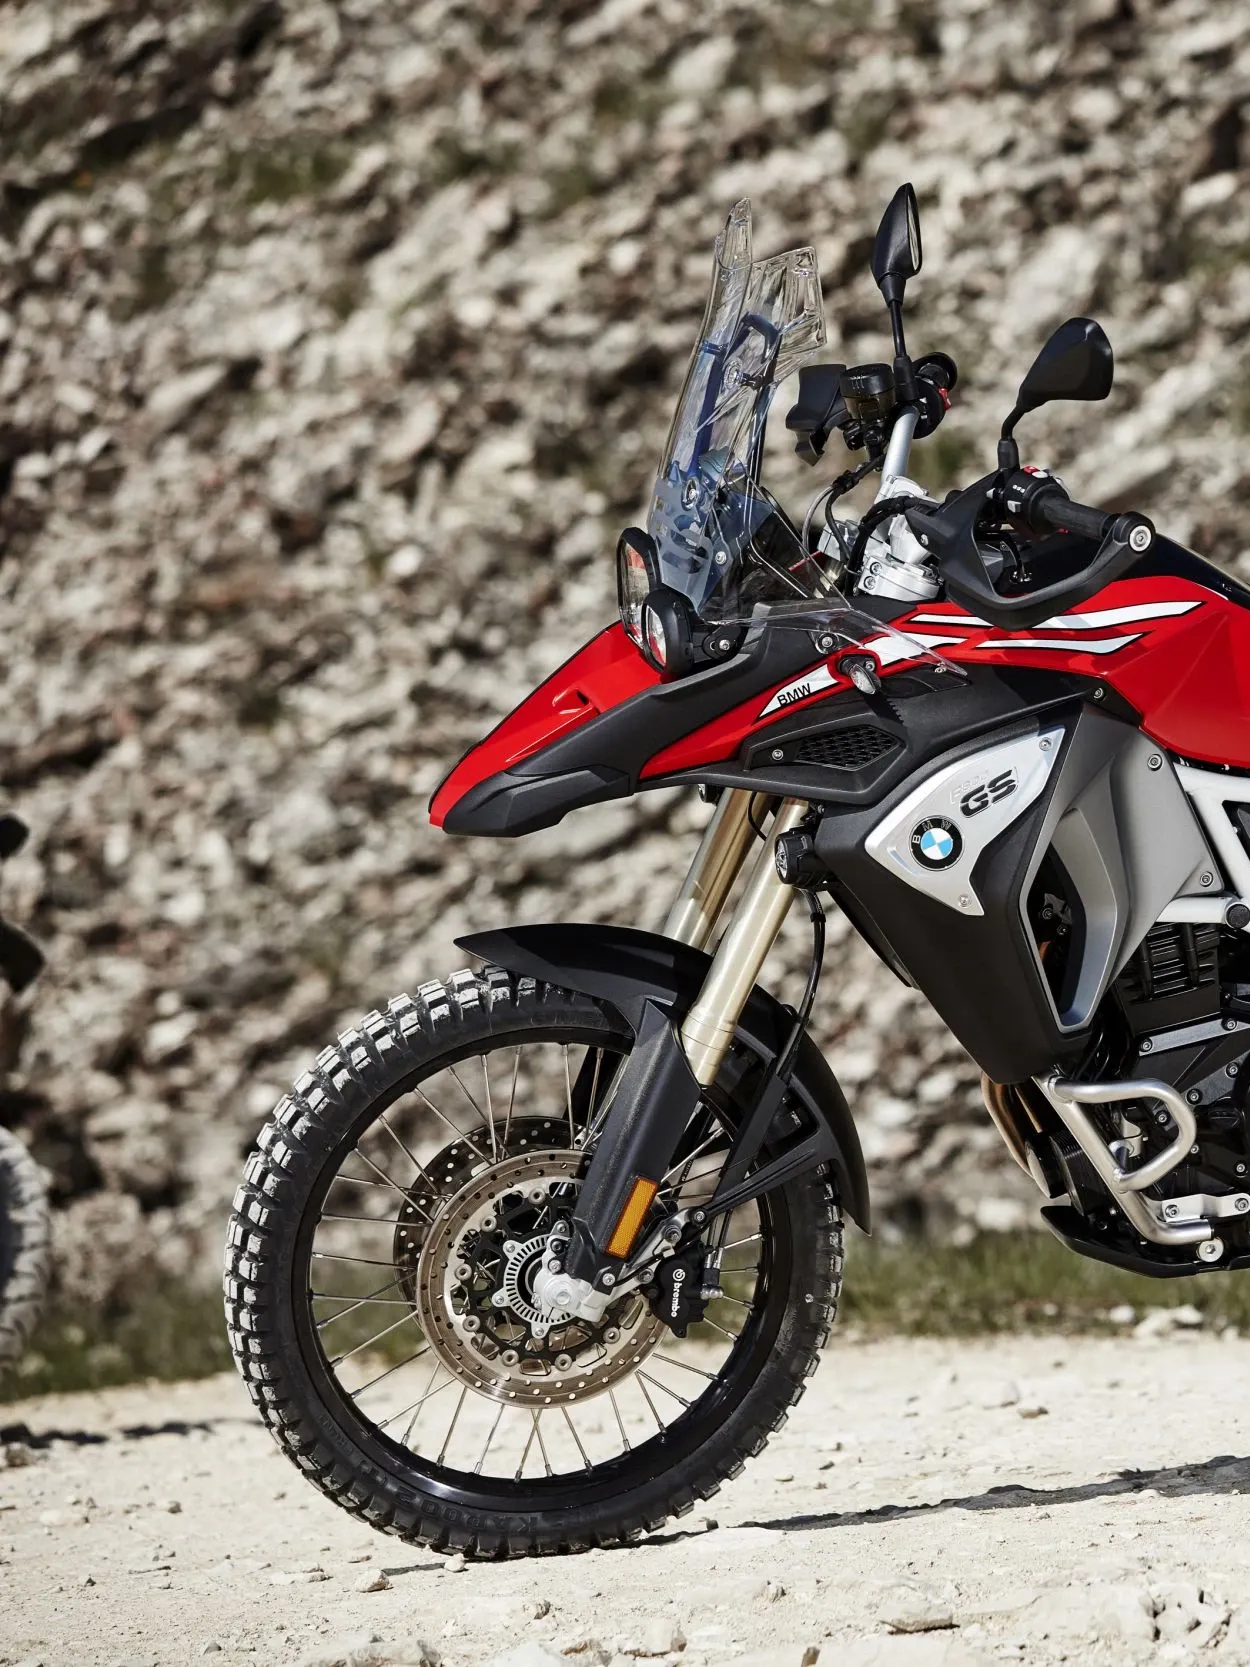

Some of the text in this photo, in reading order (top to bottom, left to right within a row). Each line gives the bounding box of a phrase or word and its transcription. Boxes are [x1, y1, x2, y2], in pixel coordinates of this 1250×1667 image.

[776, 683, 812, 706] BMW
[960, 769, 1017, 817] GS
[671, 1282, 682, 1318] brembo
